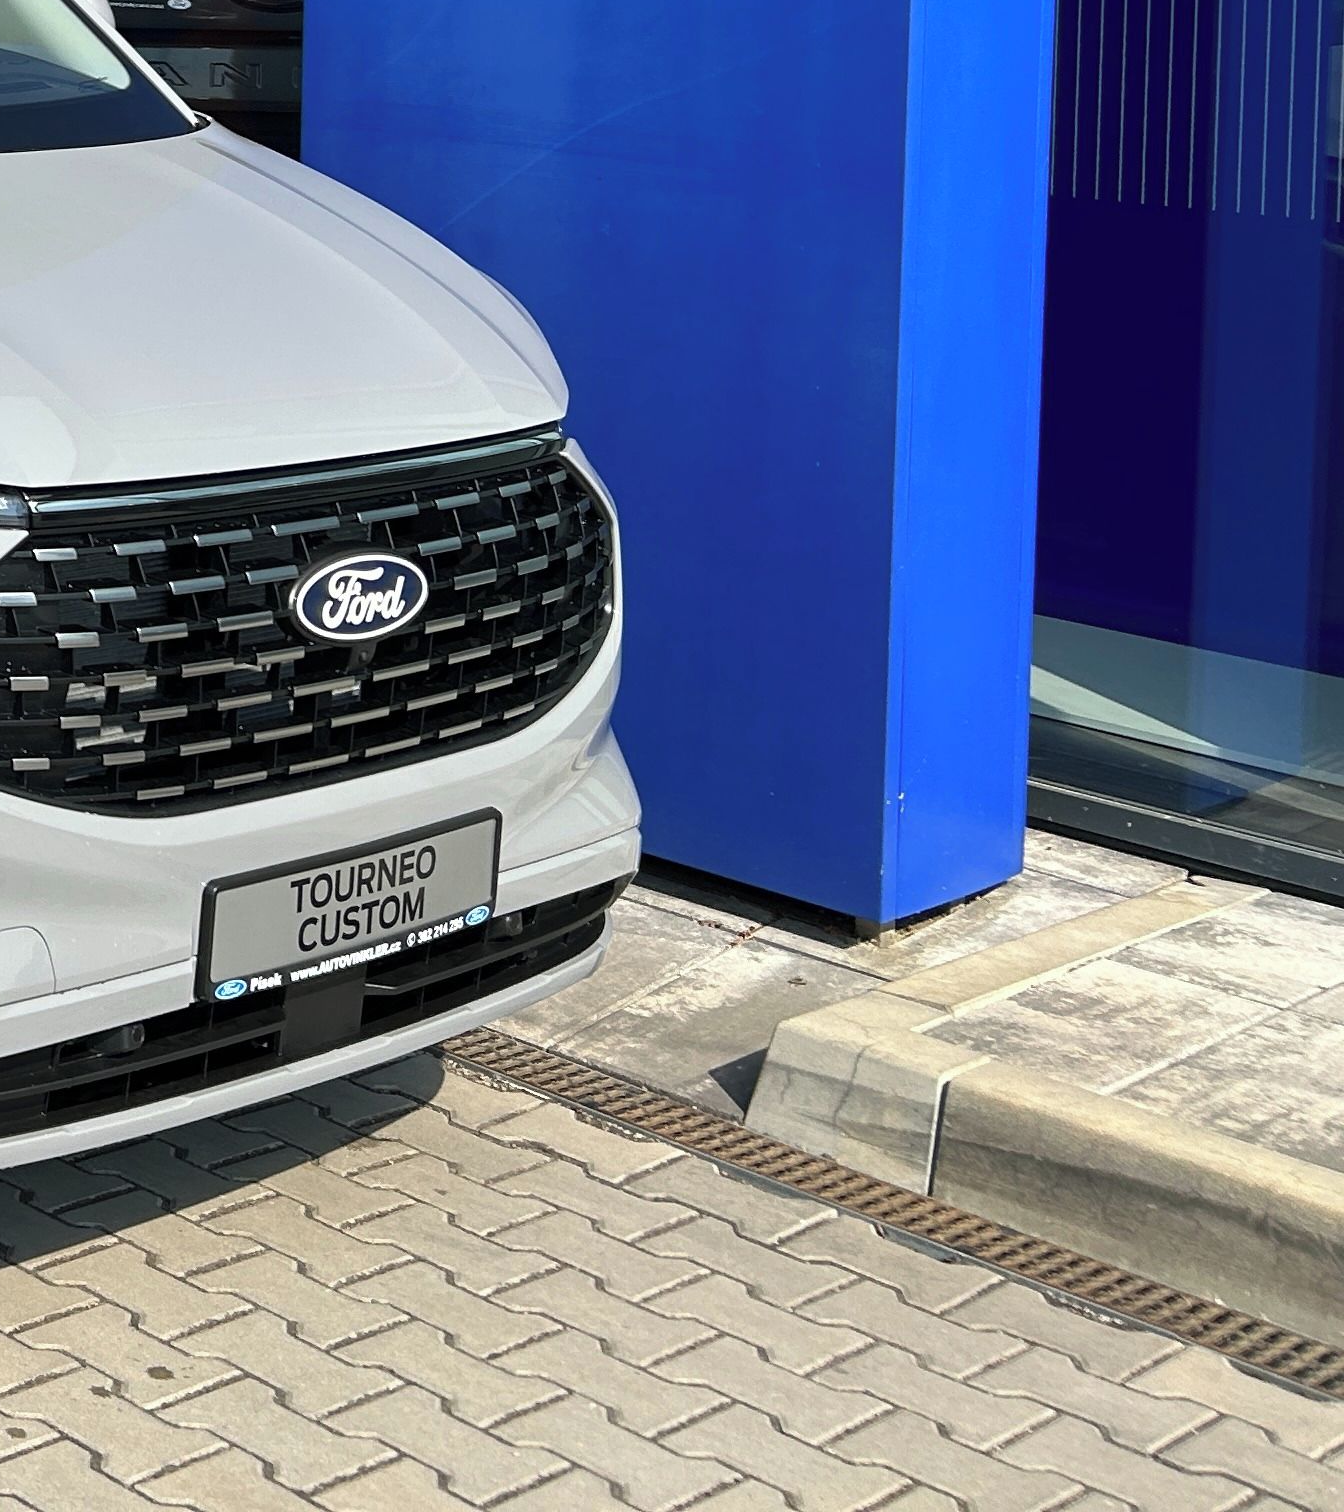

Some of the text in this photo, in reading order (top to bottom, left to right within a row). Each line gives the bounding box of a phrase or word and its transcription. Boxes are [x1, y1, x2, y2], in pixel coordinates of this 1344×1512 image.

[322, 567, 406, 629] Ford
[290, 845, 437, 914] TOURNEO
[298, 886, 426, 952] CUSTOM
[290, 941, 402, 981] www.AUTOVINKLER.cz
